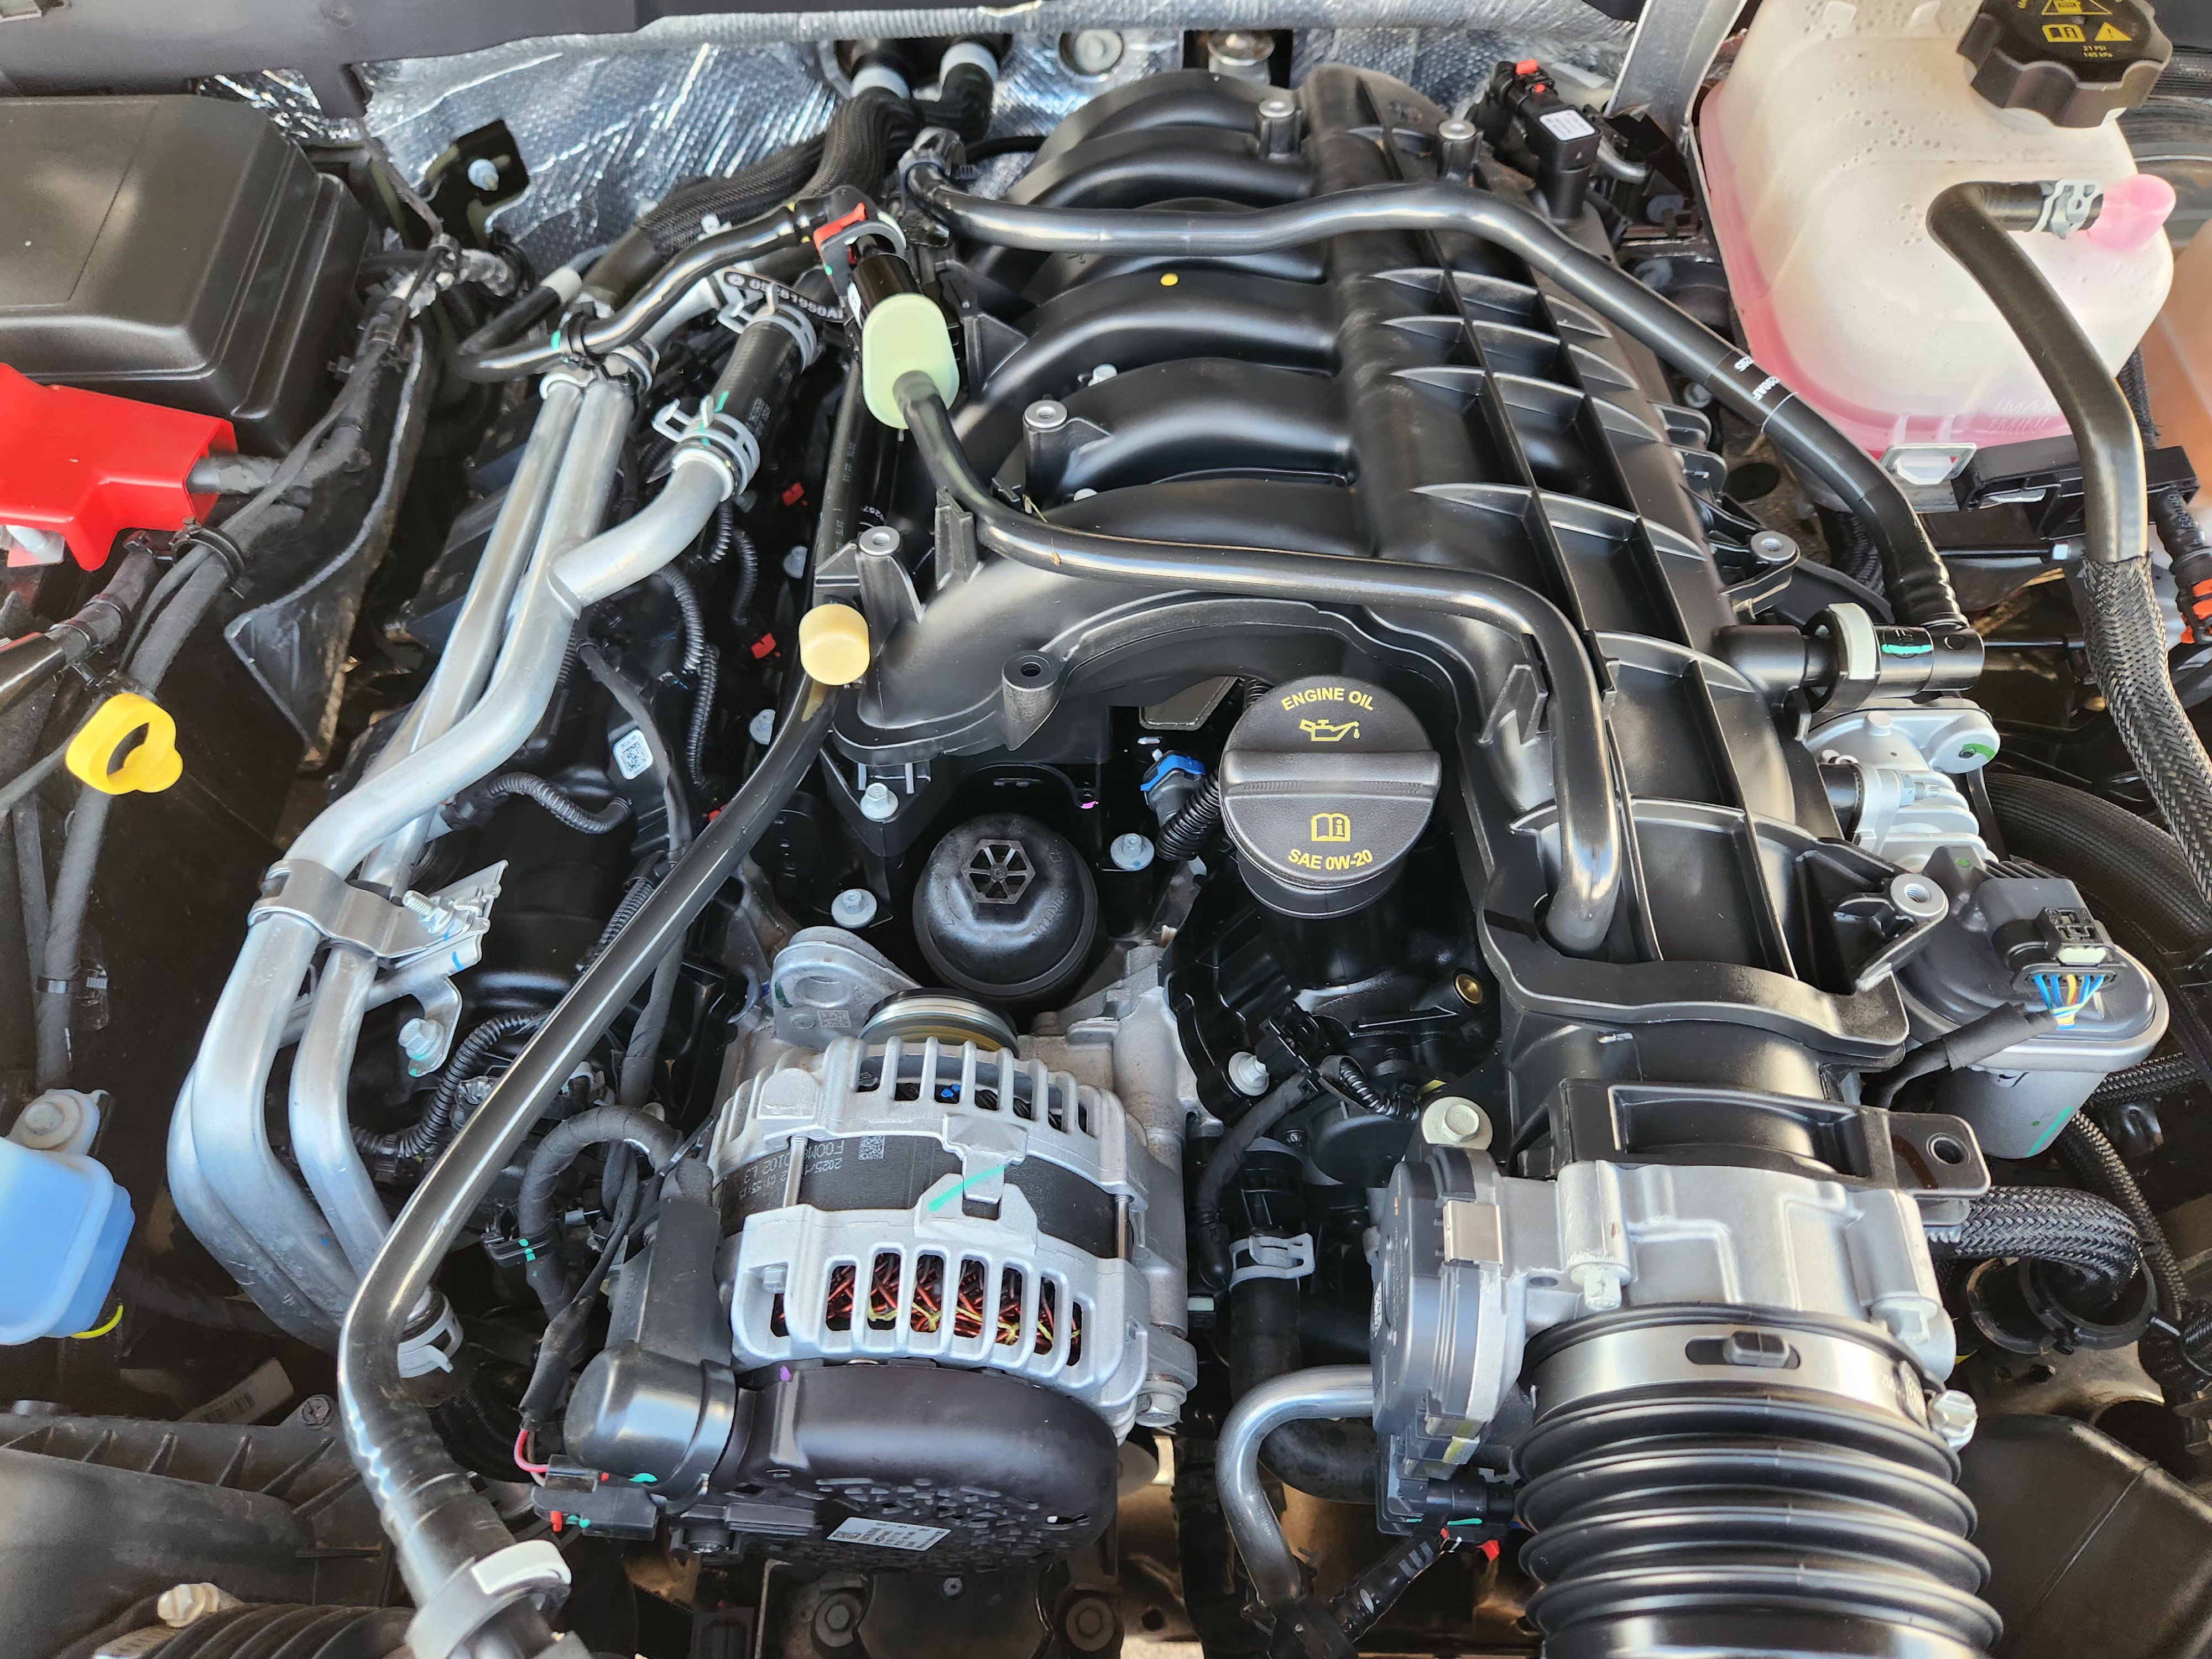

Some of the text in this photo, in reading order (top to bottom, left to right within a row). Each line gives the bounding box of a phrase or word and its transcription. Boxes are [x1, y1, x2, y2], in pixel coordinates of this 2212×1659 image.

[1281, 687, 1374, 711] ENGINE OIL
[1288, 848, 1373, 870] SAE 0W-20
